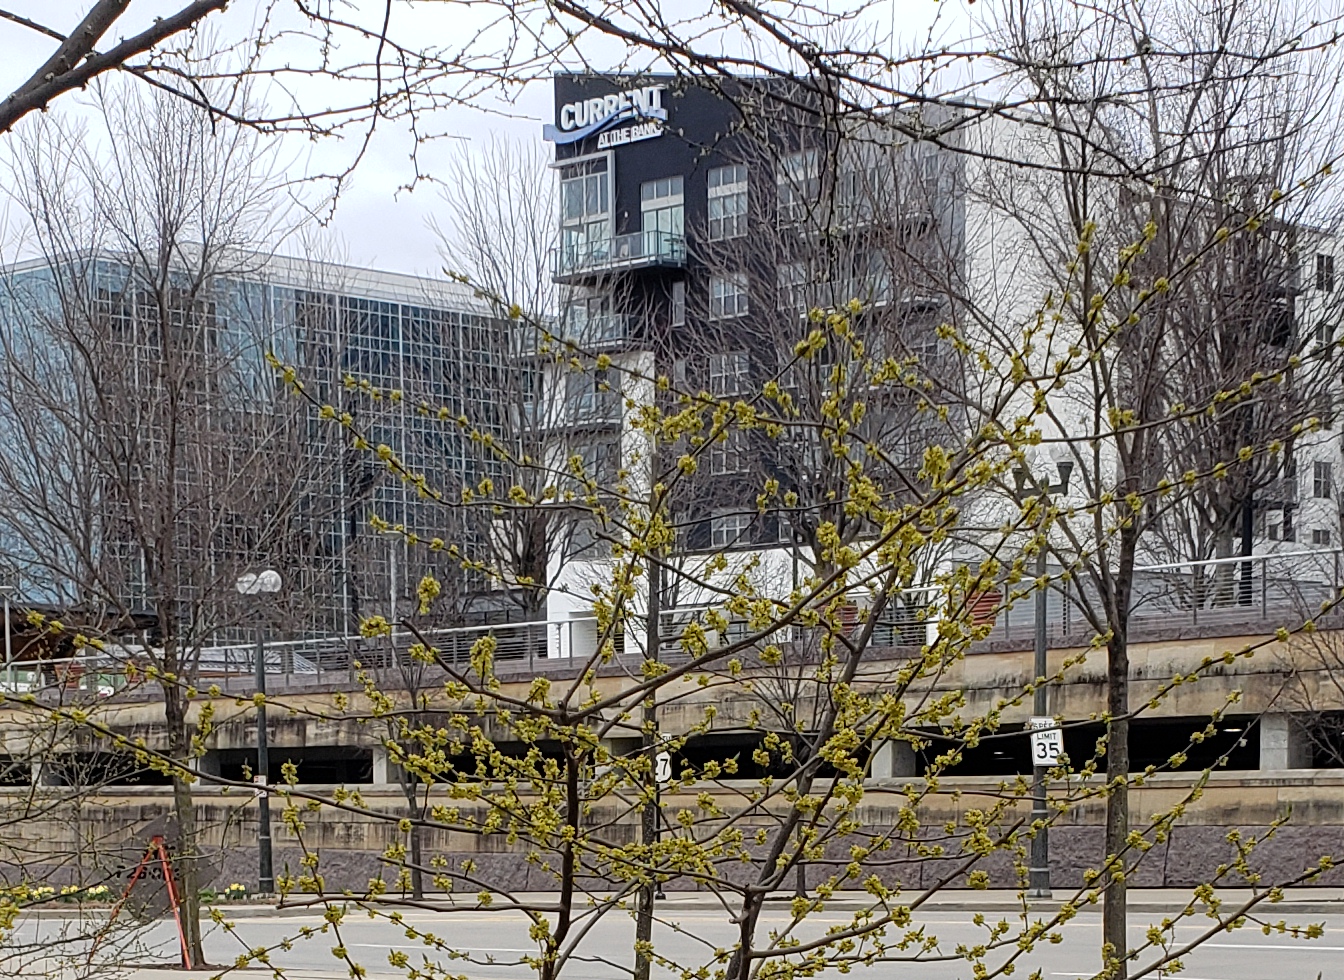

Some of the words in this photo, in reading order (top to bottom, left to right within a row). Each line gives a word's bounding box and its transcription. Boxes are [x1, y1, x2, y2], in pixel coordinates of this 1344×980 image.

[560, 84, 665, 130] CURRENT
[598, 131, 611, 149] AT
[611, 127, 630, 146] THE
[1034, 721, 1060, 730] SPEE
[1037, 742, 1060, 759] 35
